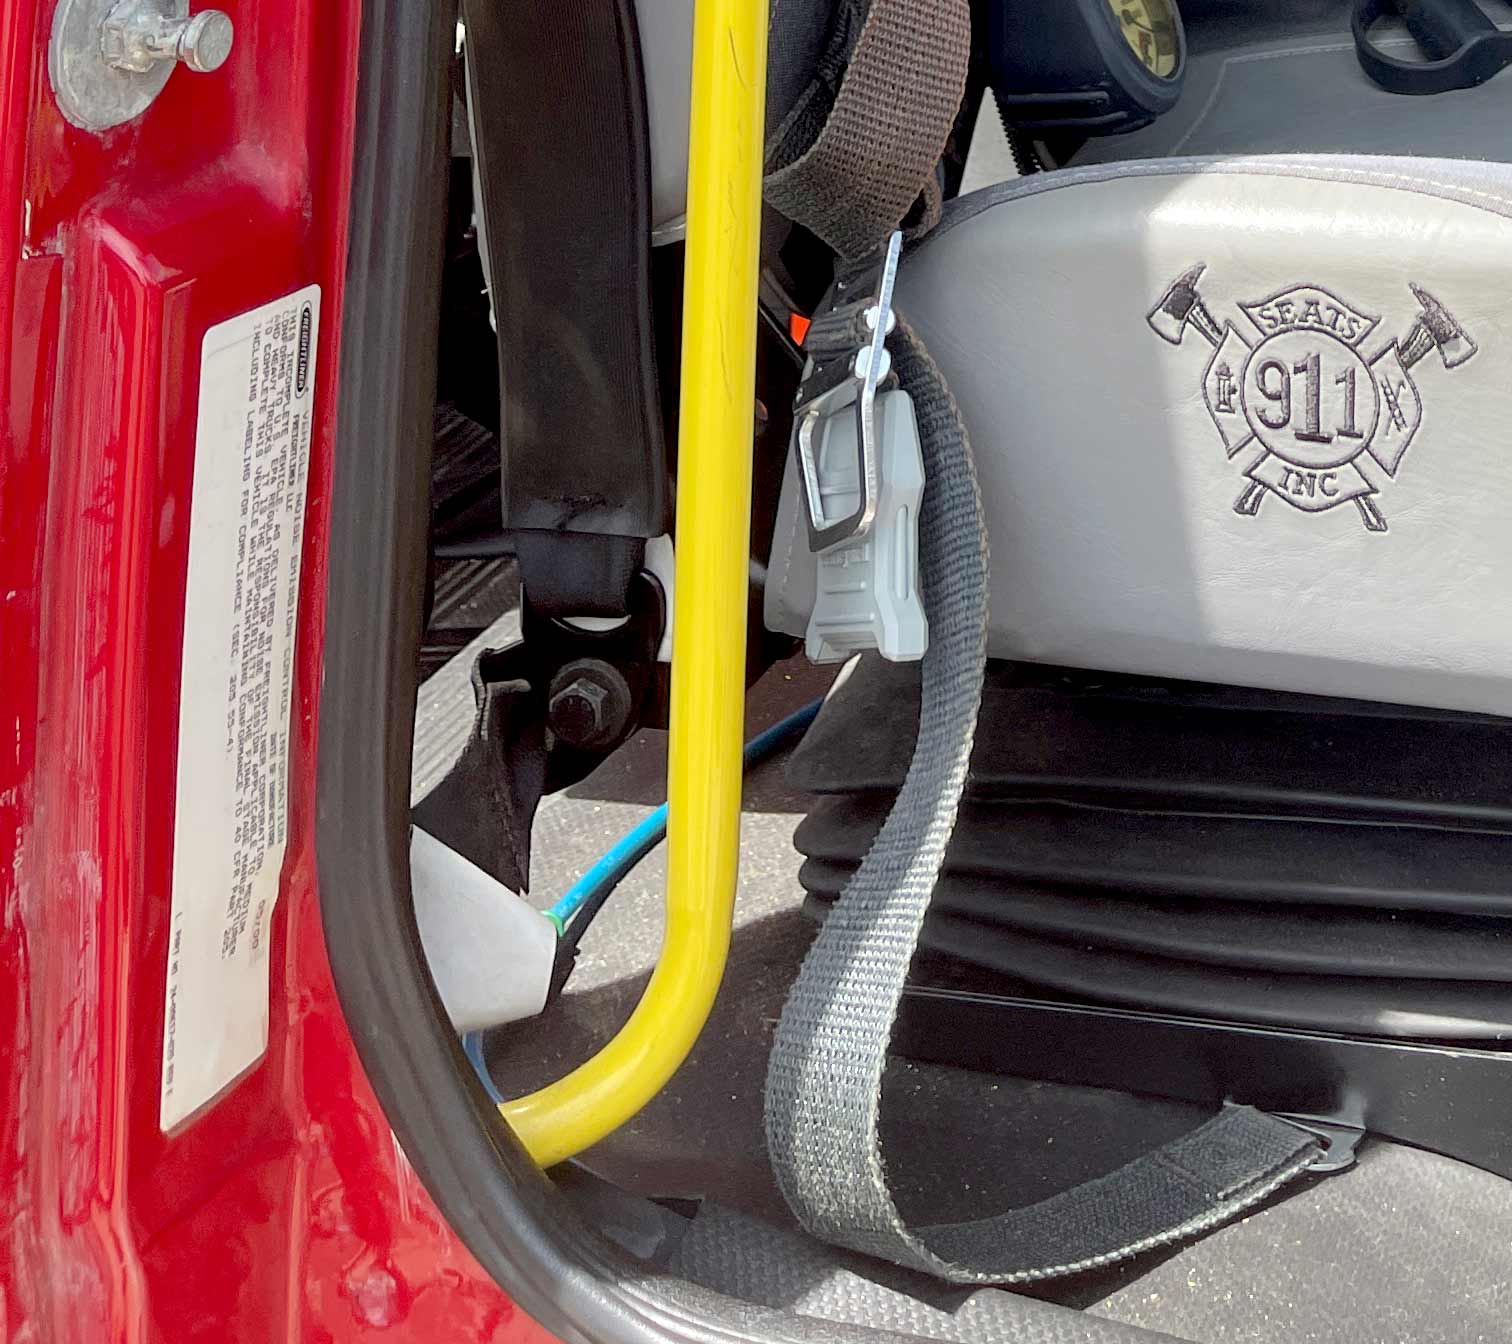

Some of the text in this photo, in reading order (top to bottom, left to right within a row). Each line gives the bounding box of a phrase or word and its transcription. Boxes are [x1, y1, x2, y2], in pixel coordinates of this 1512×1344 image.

[1257, 299, 1362, 341] SEATS
[248, 322, 261, 403] INCLUDING
[258, 342, 270, 415] COMPLETE
[268, 347, 278, 392] HEAVY
[280, 350, 293, 437] INCOMPLETE
[1255, 351, 1364, 444] 911
[242, 409, 254, 482] LABELING
[269, 457, 277, 486] EPA
[296, 408, 309, 486] VEHICLE
[1277, 466, 1340, 498] INC
[240, 488, 248, 517] FOR
[250, 464, 262, 528] VEHICLE
[292, 490, 303, 545] NOISE
[233, 523, 246, 615] COMPLIANCE
[246, 534, 257, 581] WHILE
[257, 522, 265, 550] THE
[261, 491, 275, 589] REGULATIONS
[248, 556, 263, 681] RESPONSIBILITY
[259, 595, 267, 625] FOR
[266, 548, 278, 628] DELIVERED
[285, 553, 297, 638] EMISSION
[255, 630, 265, 677] NOISE
[279, 644, 291, 721] CONTROL
[259, 660, 271, 767] FREIGHTLINER
